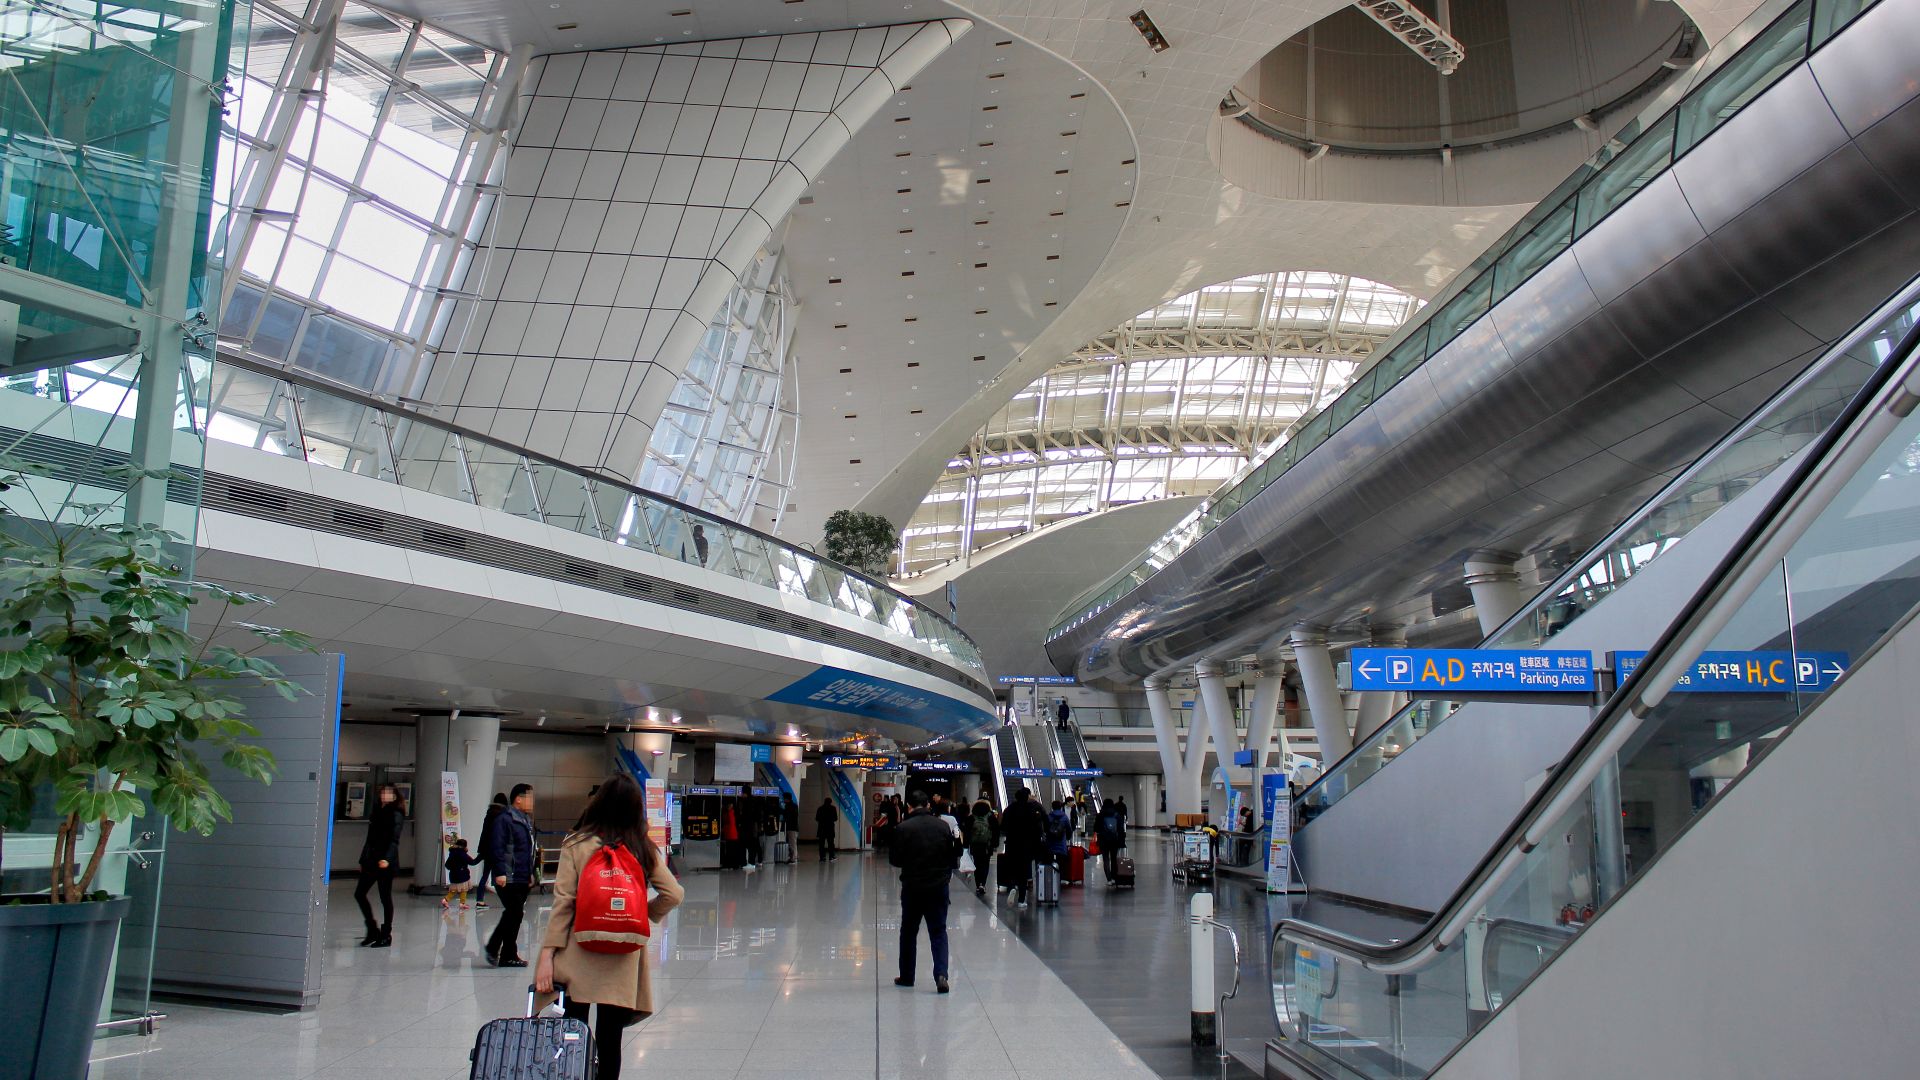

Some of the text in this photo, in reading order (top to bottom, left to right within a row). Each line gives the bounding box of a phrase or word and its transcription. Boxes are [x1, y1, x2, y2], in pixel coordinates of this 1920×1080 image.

[1393, 658, 1516, 686] P A,D 주차구역
[1520, 672, 1585, 688] Parking Area
[1697, 659, 1814, 687] 주차구역 H,C P
